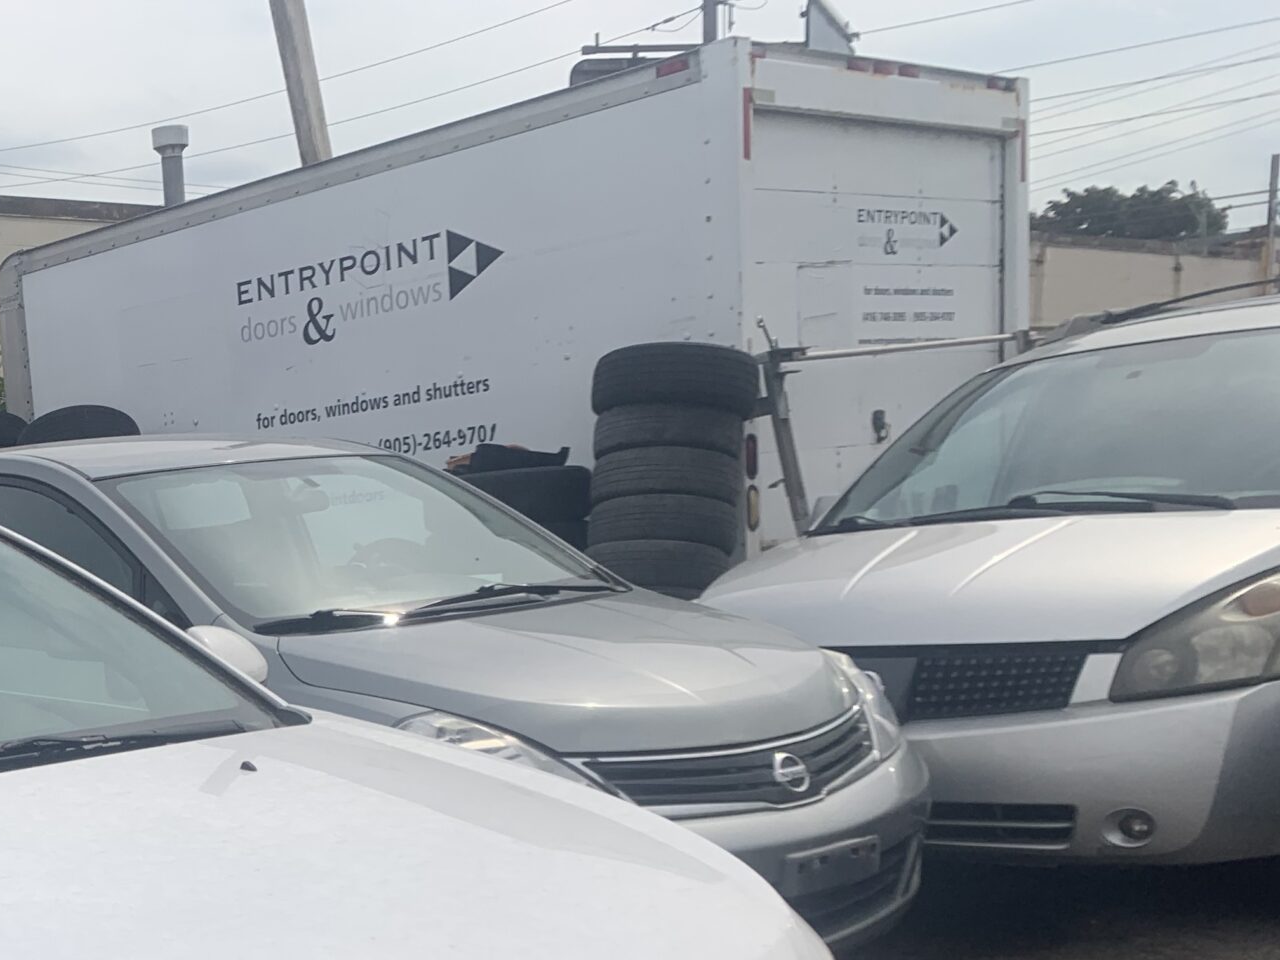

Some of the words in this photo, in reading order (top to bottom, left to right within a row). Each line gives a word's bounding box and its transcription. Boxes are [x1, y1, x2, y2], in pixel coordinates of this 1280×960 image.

[856, 208, 939, 226] ENTRYPOINT
[883, 228, 898, 255] &
[236, 231, 442, 306] ENTRYPOINT
[240, 314, 297, 343] doors
[302, 296, 336, 346] &
[339, 281, 443, 323] windows
[256, 413, 276, 431] for
[279, 406, 322, 427] doors,
[325, 393, 389, 419] windows
[393, 385, 421, 408] and
[425, 376, 490, 402] shutters
